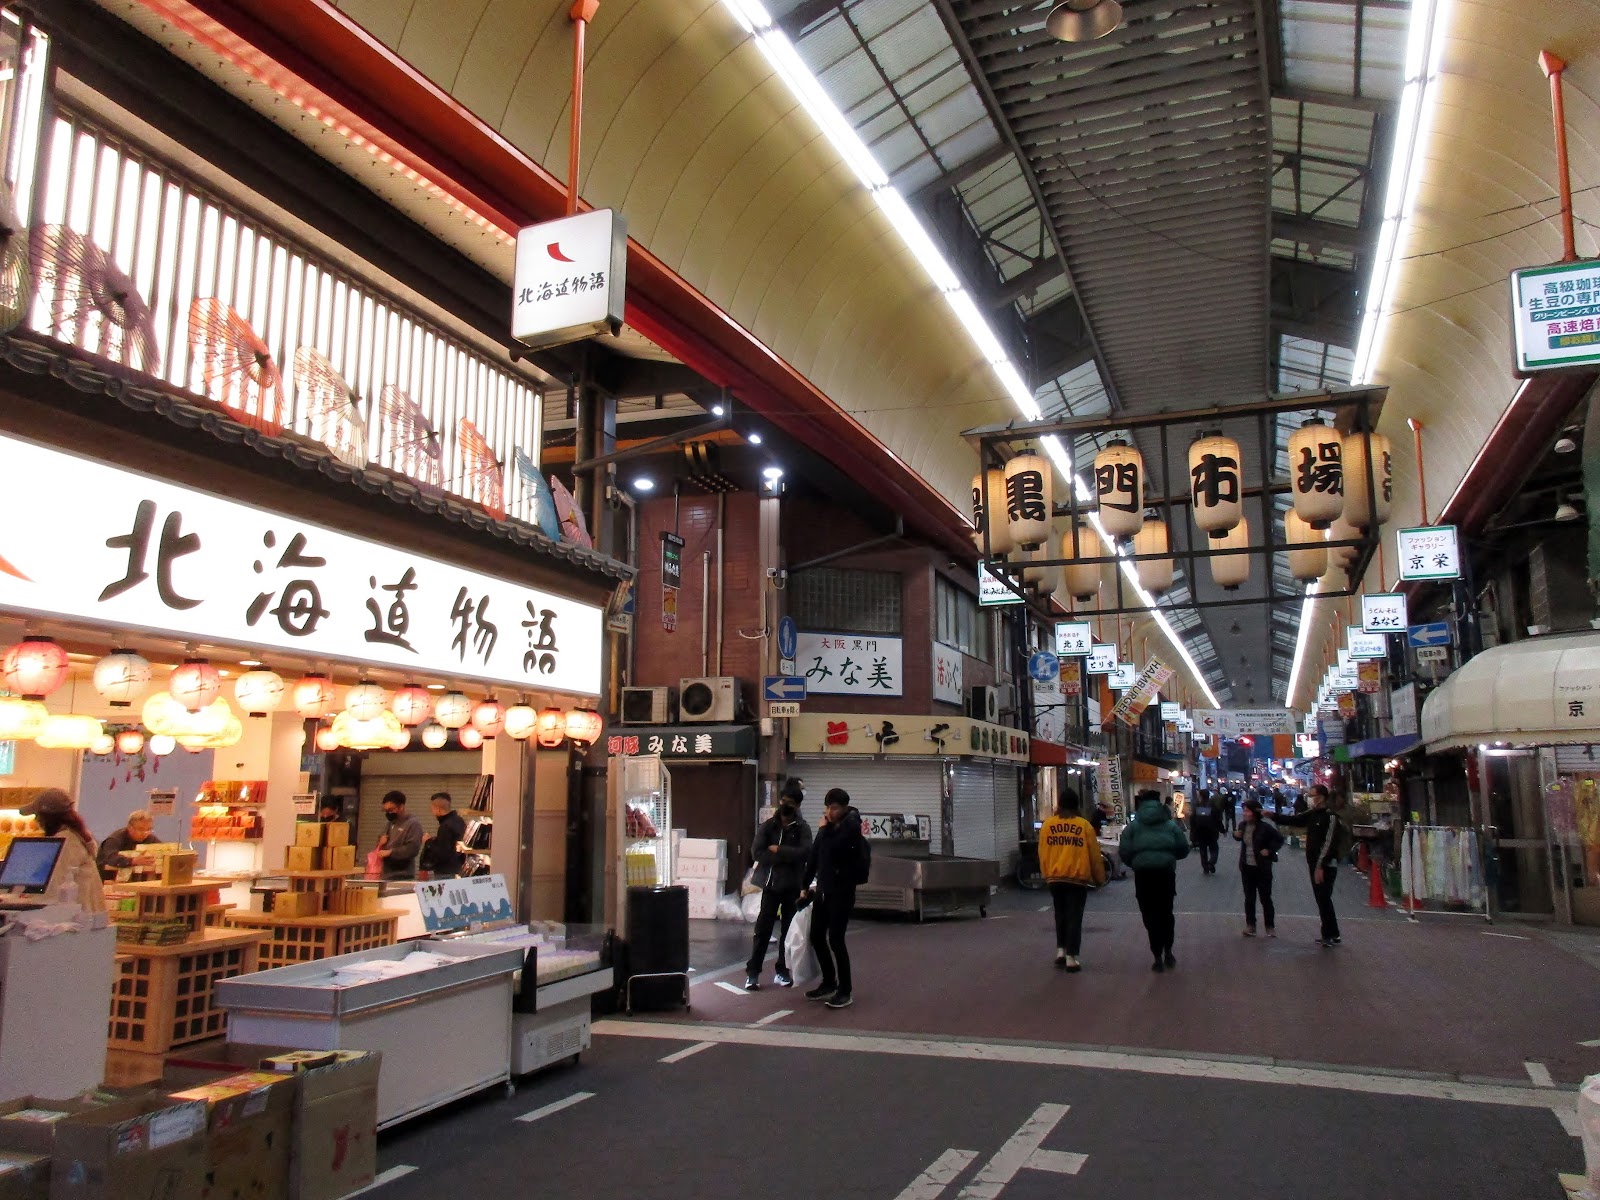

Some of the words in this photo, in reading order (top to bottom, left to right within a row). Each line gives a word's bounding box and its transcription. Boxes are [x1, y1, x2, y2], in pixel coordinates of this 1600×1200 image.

[518, 271, 606, 306] 北海道物語
[1547, 317, 1600, 336] 高速焙
[1407, 535, 1447, 544] ファッション
[1411, 543, 1445, 551] ギャラリー
[1409, 553, 1450, 570] 京栄
[98, 499, 561, 676] 北海道物語
[1370, 616, 1400, 627] みなと
[820, 638, 878, 652] 大阪黒門
[806, 656, 893, 690] みな美
[1115, 659, 1161, 716] HAMBURGER
[771, 706, 798, 714] 自転車を除く
[1568, 700, 1584, 717] 京
[648, 733, 713, 754] みな美
[1050, 823, 1082, 836] RODEO
[1047, 835, 1084, 847] CROWNS
